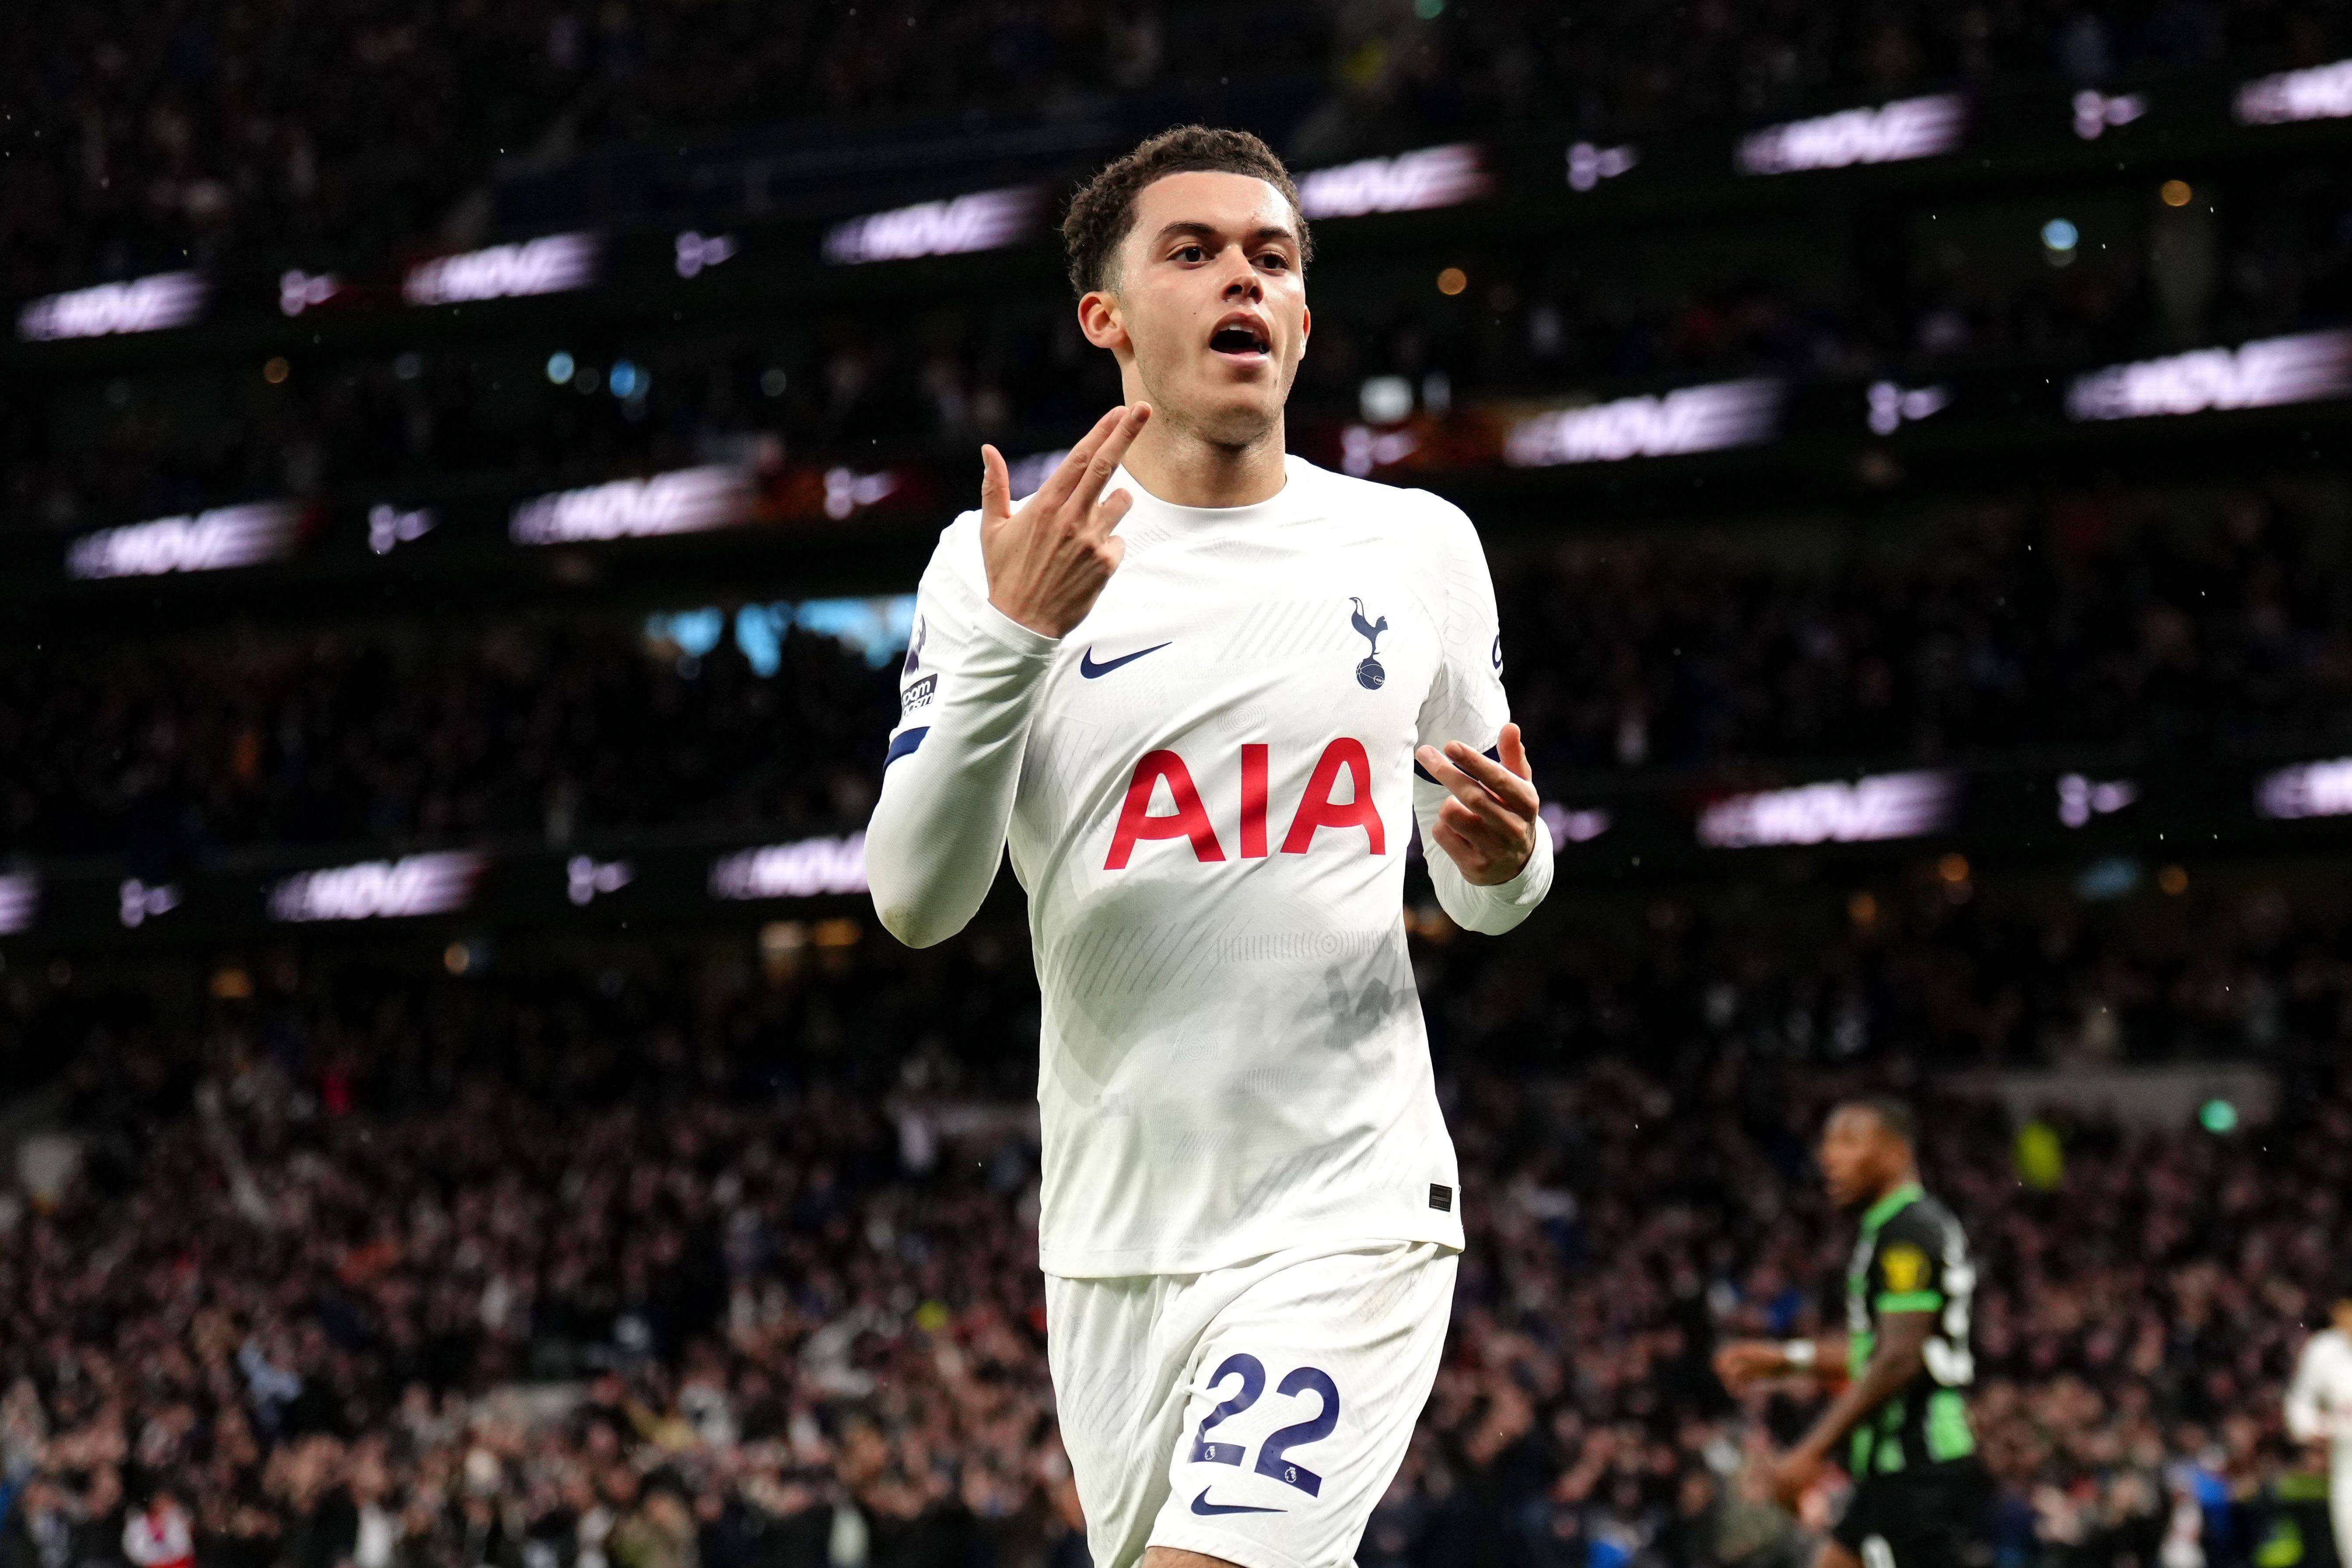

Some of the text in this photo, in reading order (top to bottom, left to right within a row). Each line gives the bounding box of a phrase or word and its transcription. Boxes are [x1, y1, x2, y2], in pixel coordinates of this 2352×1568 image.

[902, 680, 931, 706] oom
[1103, 737, 1386, 870] AIA
[1187, 1353, 1340, 1498] 22
